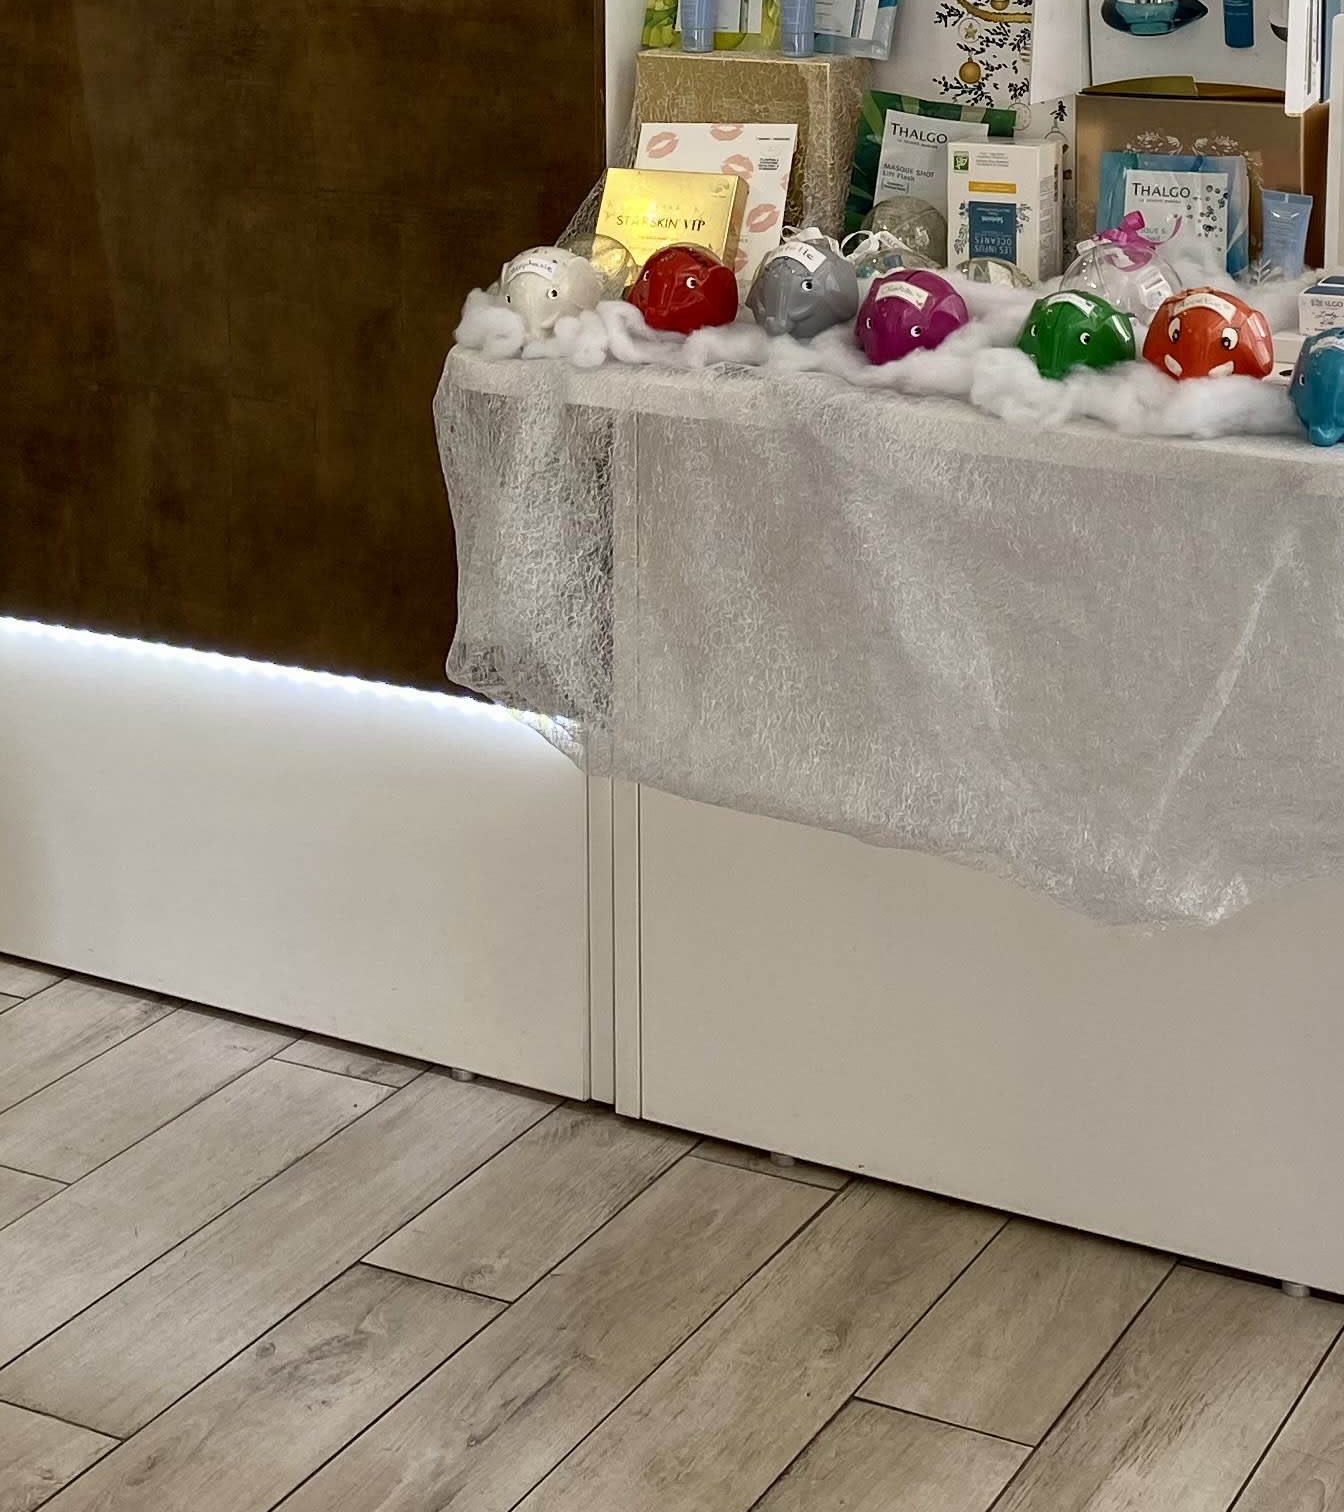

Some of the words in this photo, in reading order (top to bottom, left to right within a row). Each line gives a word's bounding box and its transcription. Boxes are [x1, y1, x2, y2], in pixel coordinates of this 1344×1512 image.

[891, 122, 948, 144] THALGO
[883, 163, 914, 176] MASQUE
[1131, 182, 1190, 199] THALGO
[683, 217, 706, 232] VIP
